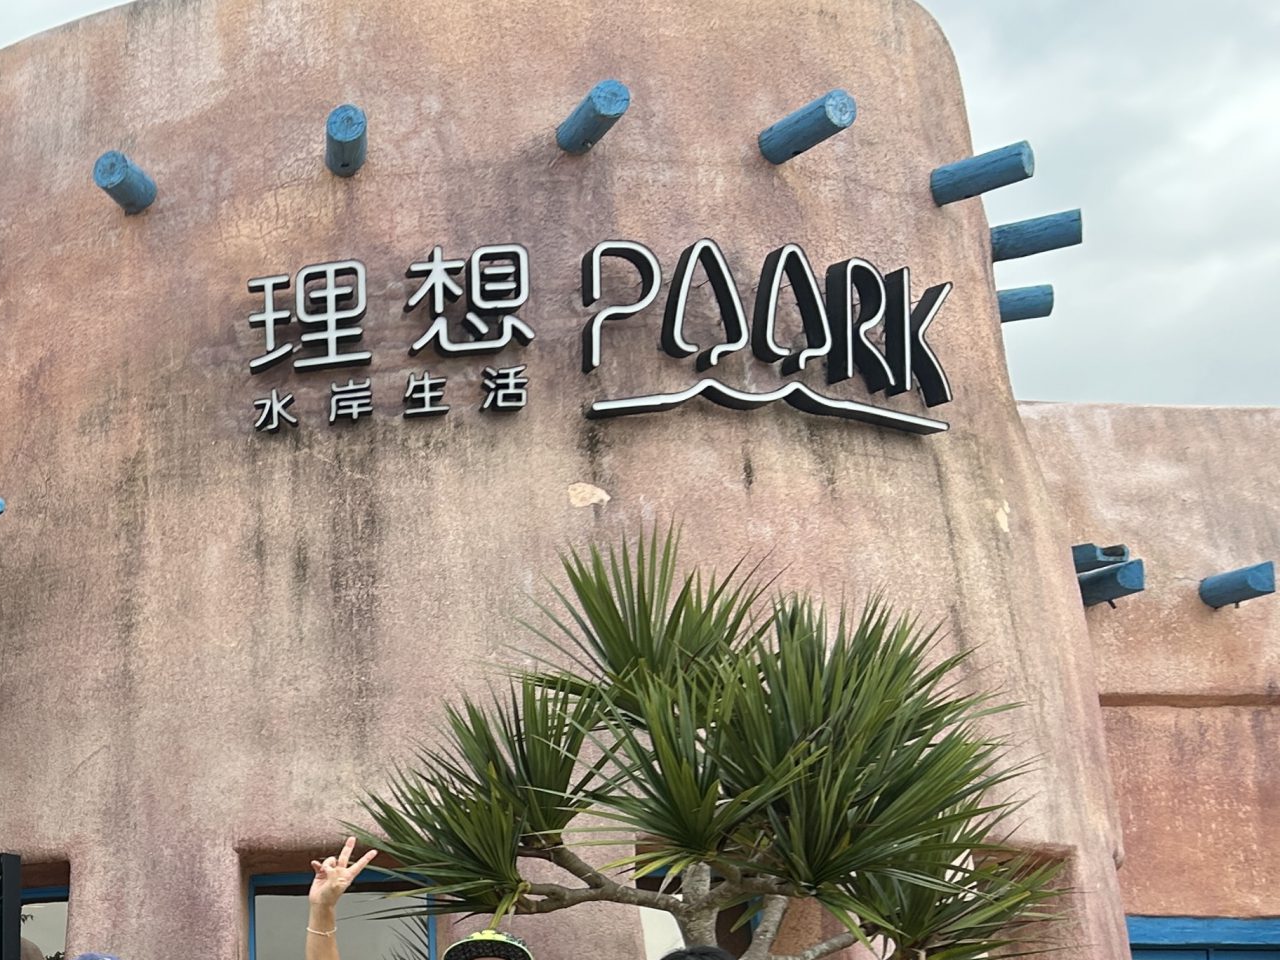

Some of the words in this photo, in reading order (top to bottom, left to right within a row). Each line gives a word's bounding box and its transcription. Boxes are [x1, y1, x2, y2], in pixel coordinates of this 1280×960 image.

[247, 242, 536, 374] 理想
[253, 364, 529, 433] 水岸生活
